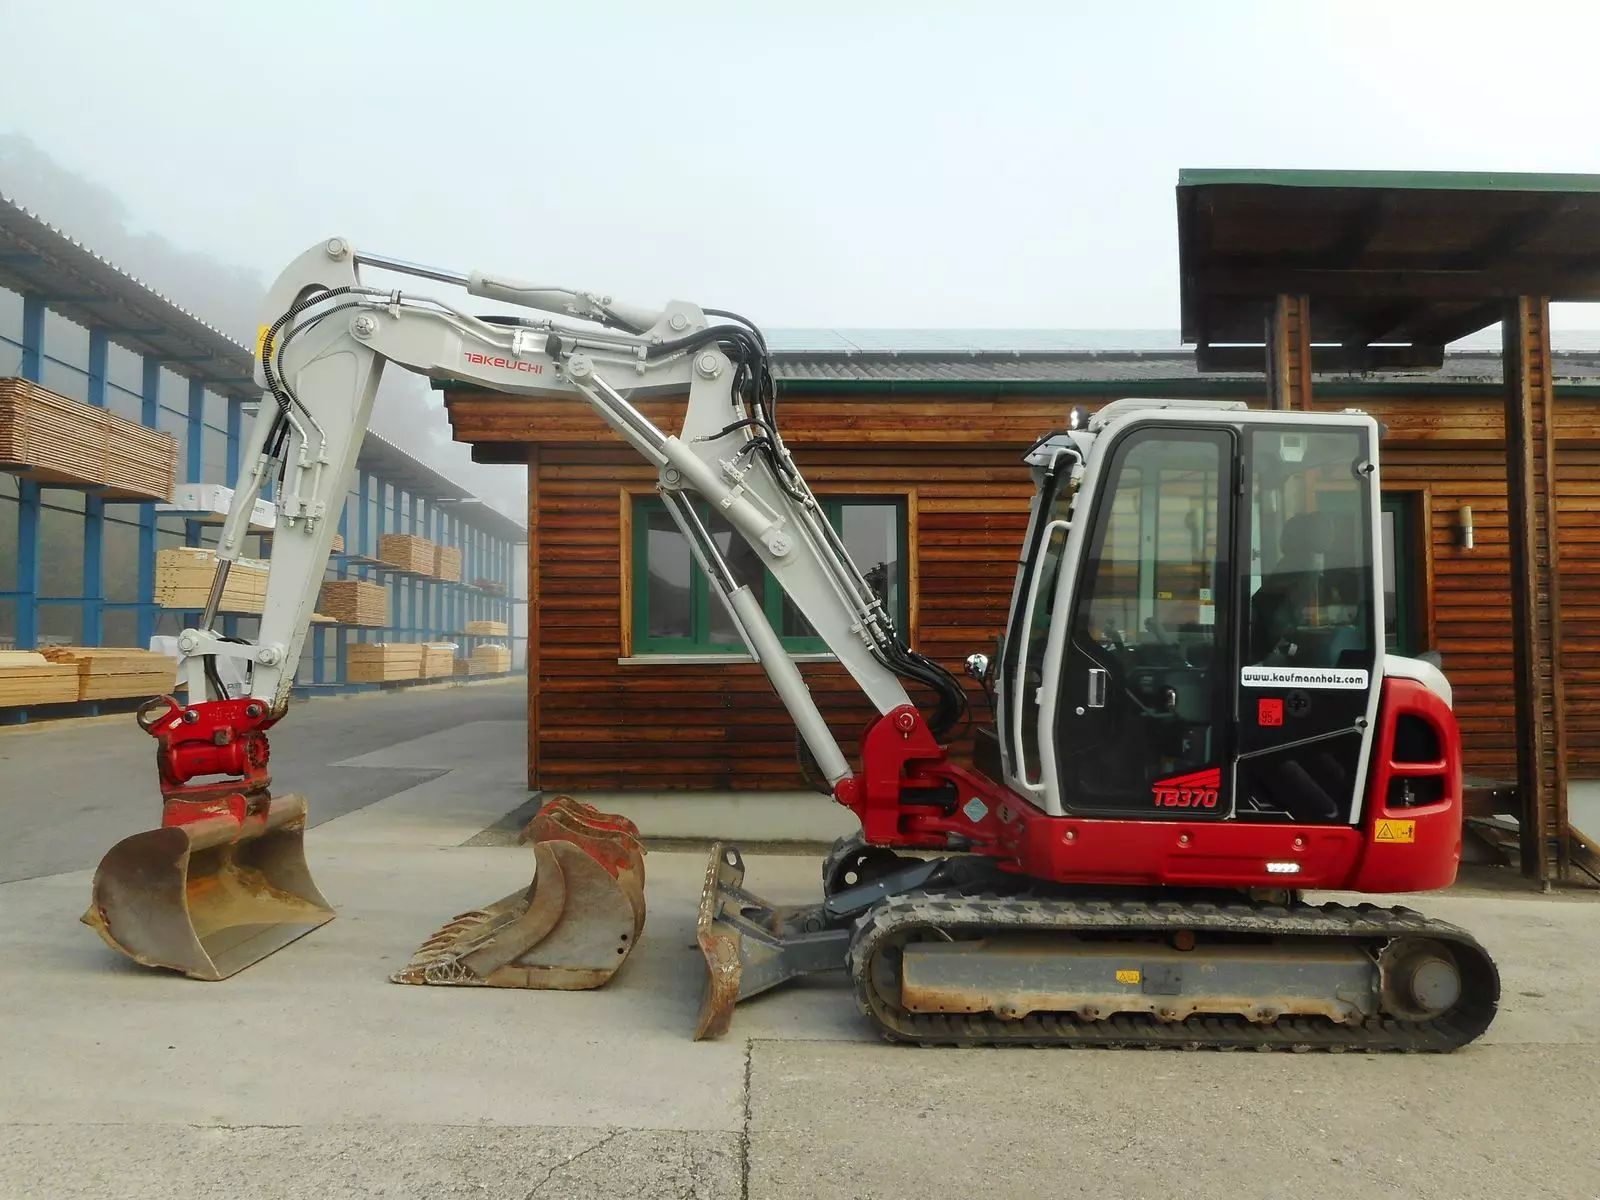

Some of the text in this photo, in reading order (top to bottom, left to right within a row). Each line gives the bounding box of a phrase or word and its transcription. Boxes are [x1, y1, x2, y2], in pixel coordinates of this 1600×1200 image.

[464, 352, 544, 375] TAKEUCHI
[1243, 671, 1364, 685] www.kaufmannholz.com
[1151, 788, 1218, 808] TB370
